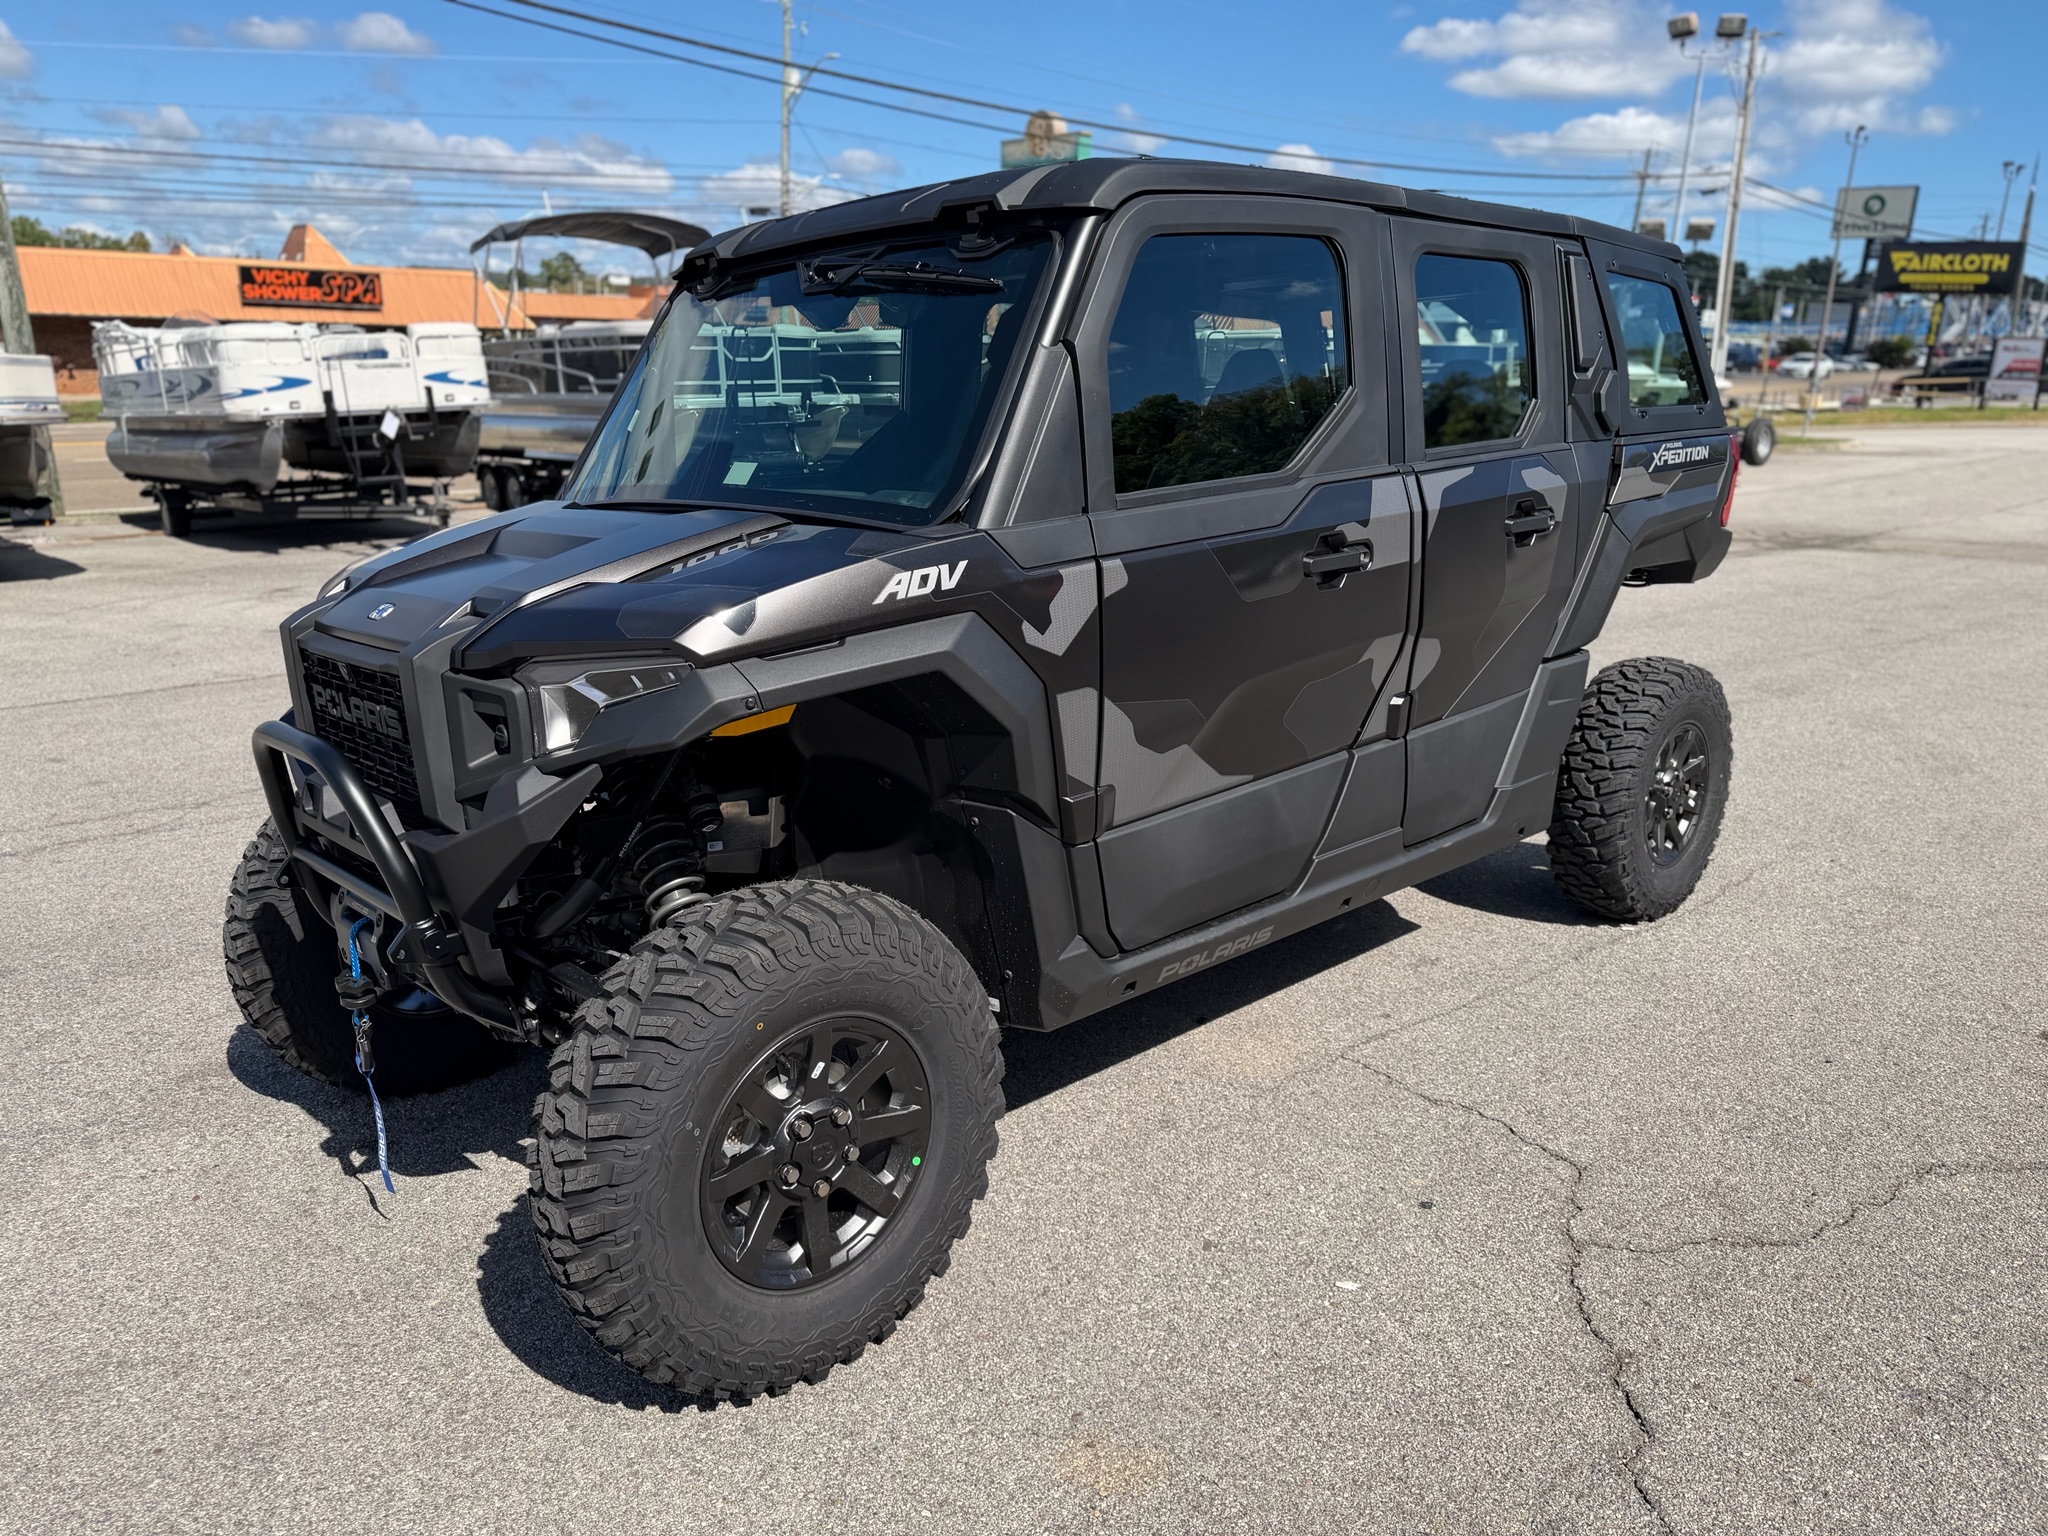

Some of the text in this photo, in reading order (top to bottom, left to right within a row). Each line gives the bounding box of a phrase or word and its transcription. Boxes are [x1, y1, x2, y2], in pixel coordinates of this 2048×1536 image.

[251, 268, 309, 286] VICHY
[1890, 251, 2010, 272] FAIRCLOTH
[243, 283, 323, 303] SHOWER
[321, 271, 381, 305] SPA
[1648, 443, 1710, 473] XPEDITION
[671, 531, 778, 574] 1000
[872, 559, 969, 605] ADV
[311, 683, 403, 739] POLARIS
[1157, 924, 1275, 983] POLARIS
